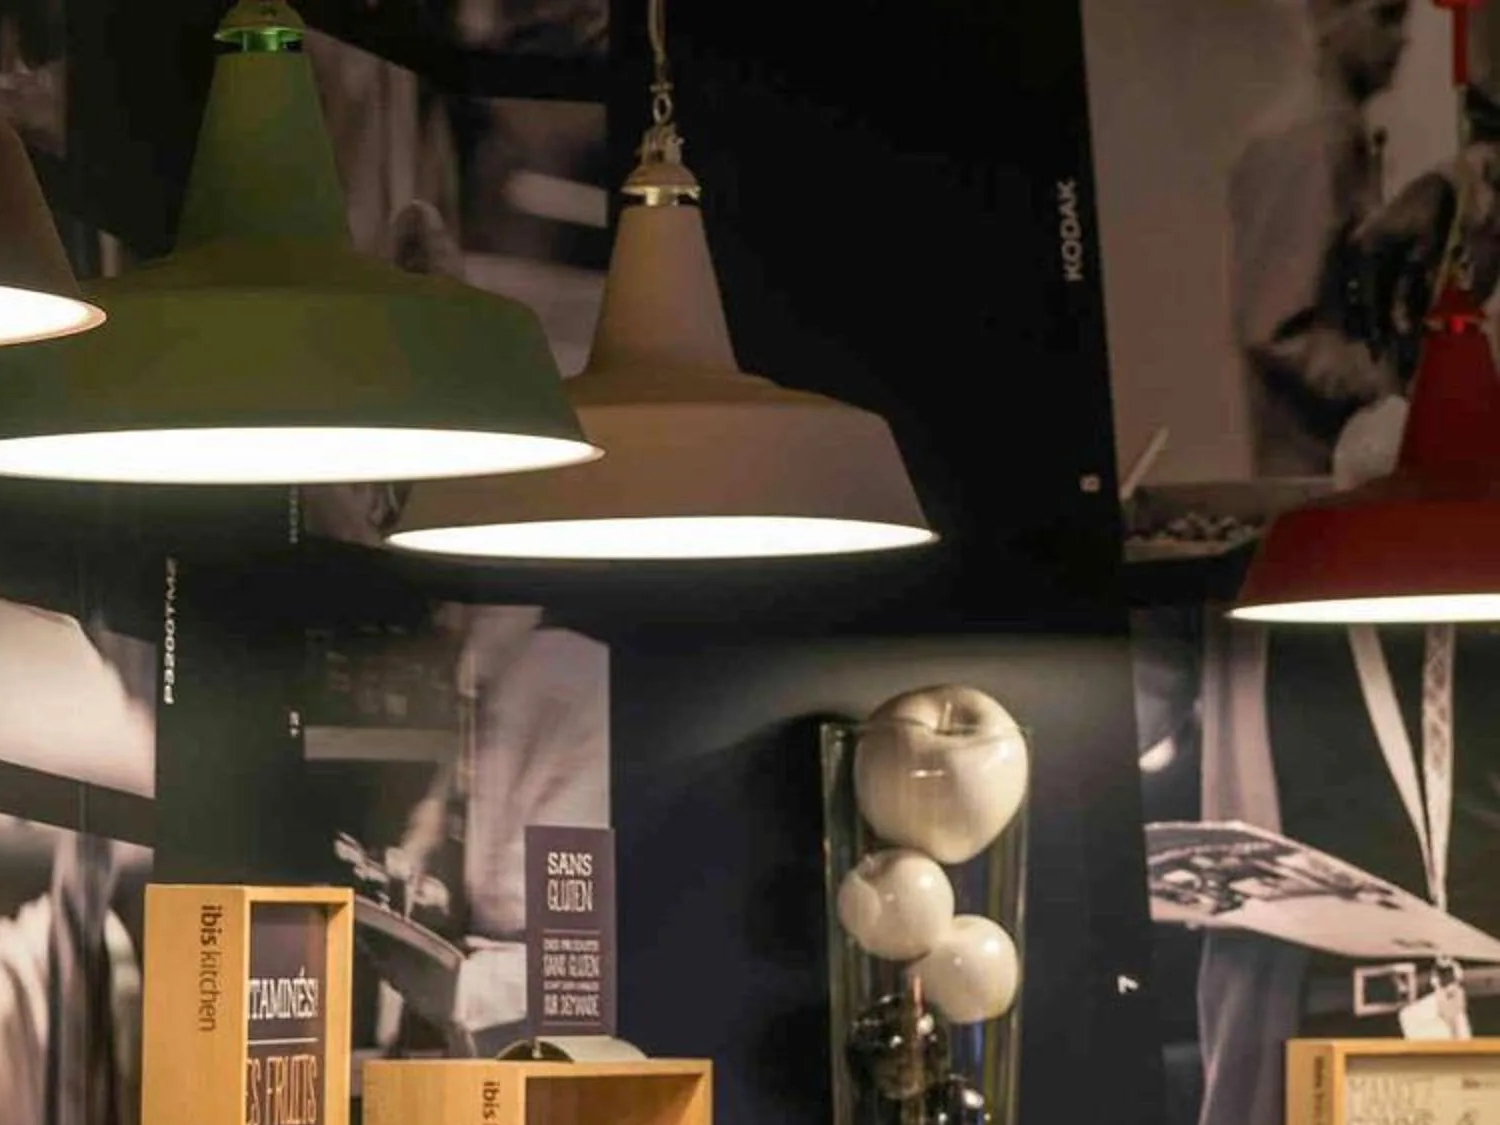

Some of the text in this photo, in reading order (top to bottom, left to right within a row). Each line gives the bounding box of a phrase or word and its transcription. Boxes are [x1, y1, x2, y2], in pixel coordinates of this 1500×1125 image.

[1057, 178, 1083, 281] KODAK
[547, 852, 593, 877] SANS
[199, 904, 223, 1032] ibis kitchen
[483, 1080, 501, 1118] ibis
